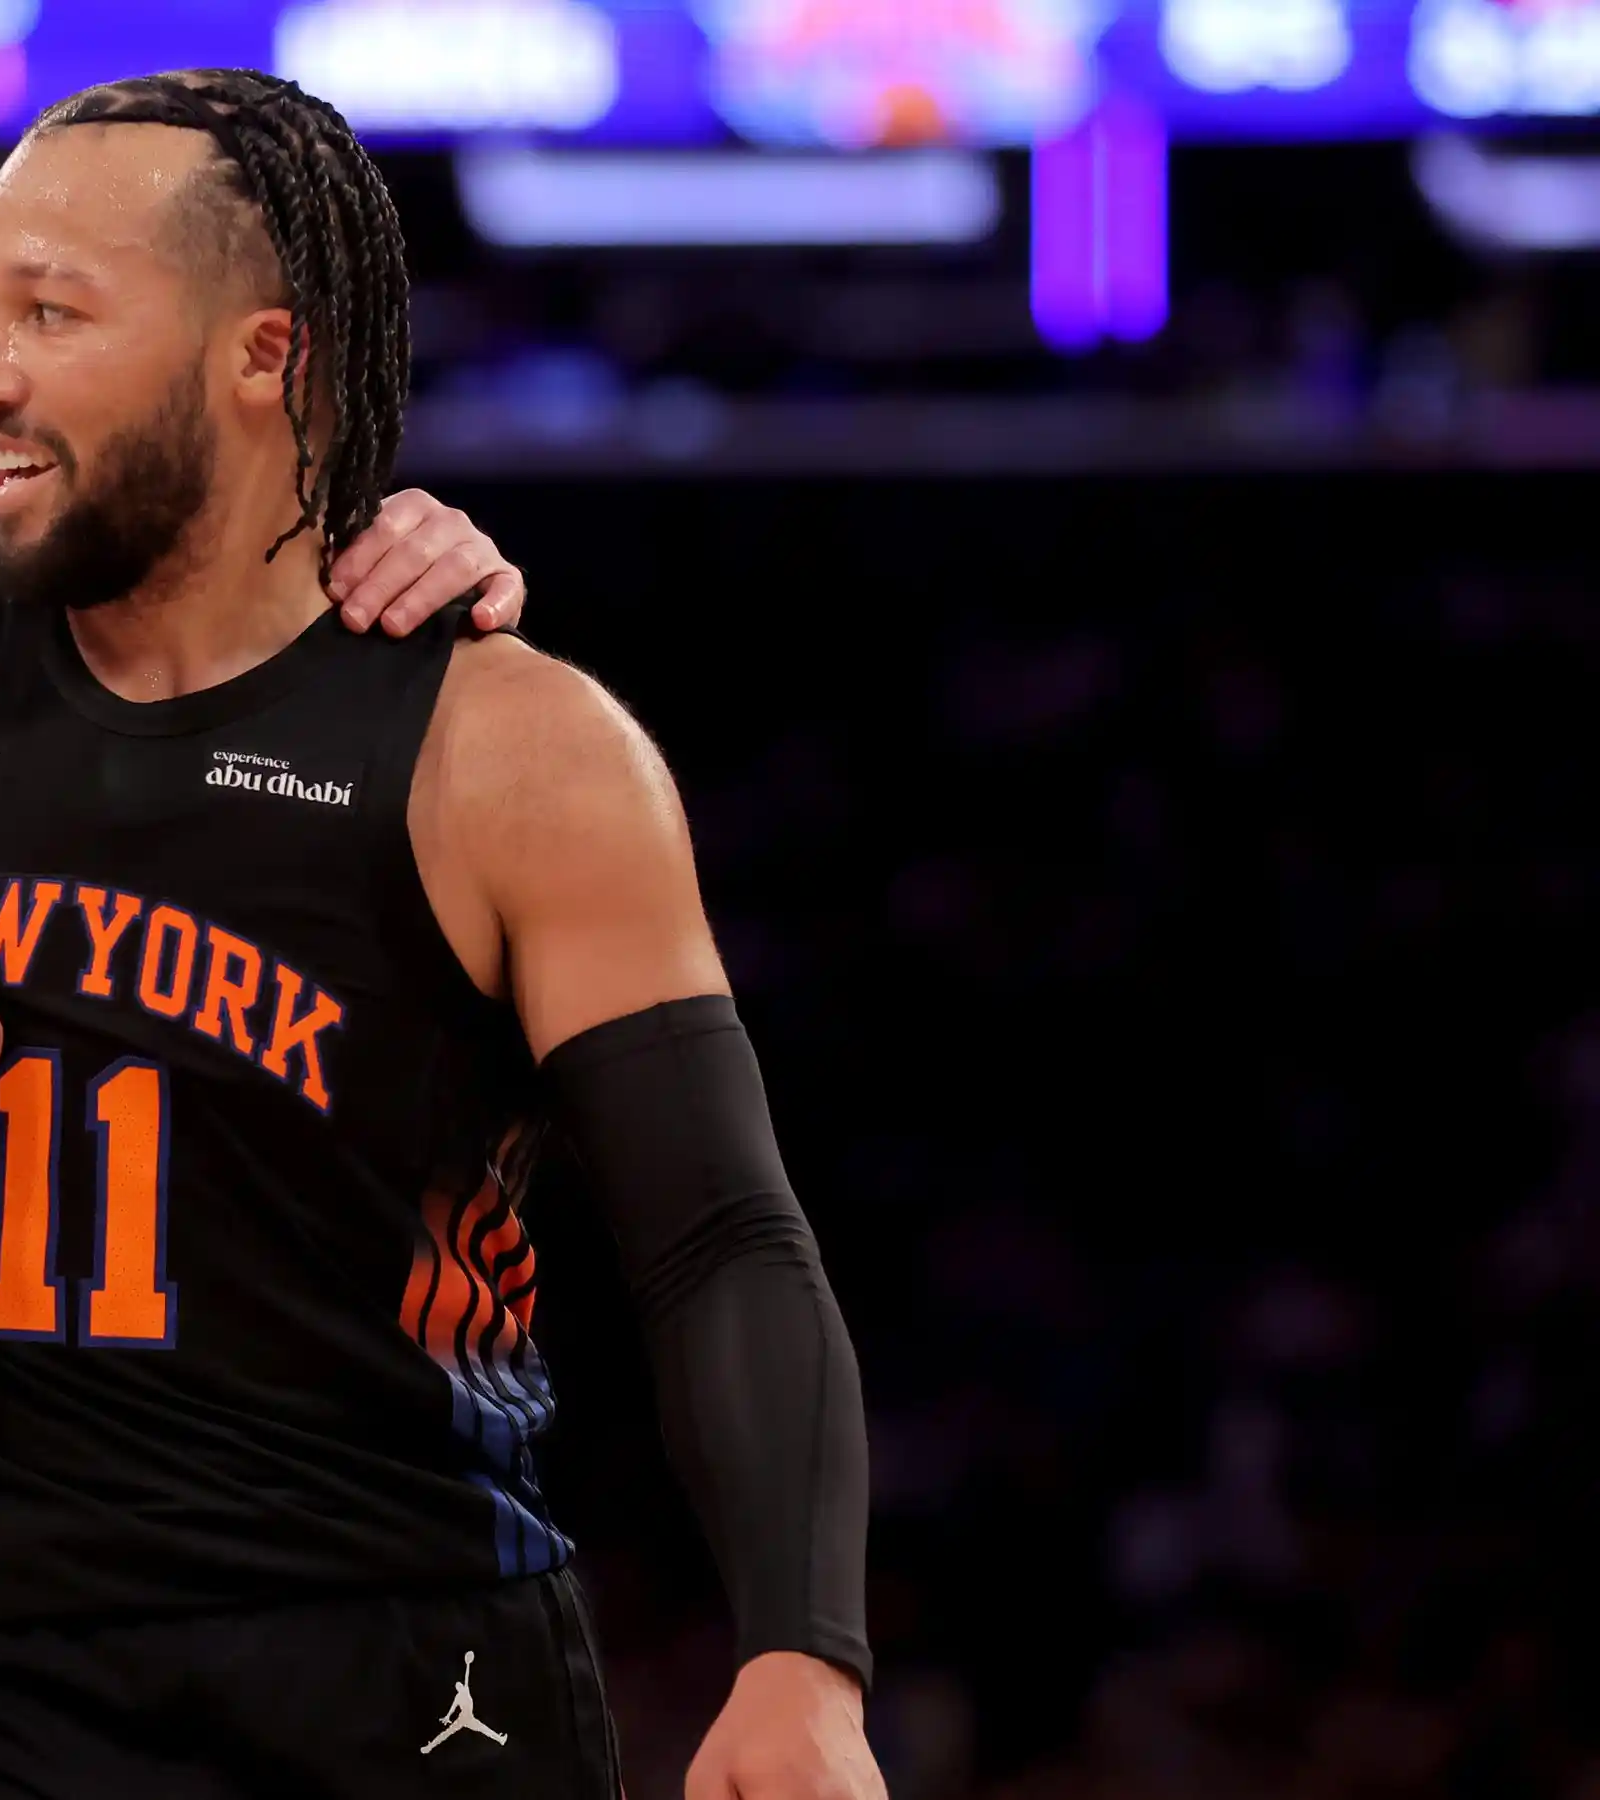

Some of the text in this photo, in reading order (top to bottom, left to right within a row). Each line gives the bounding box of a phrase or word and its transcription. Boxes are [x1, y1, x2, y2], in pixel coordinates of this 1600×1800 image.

[212, 750, 291, 770] experience
[204, 763, 354, 806] abu dhabi
[73, 881, 350, 1117] YORK
